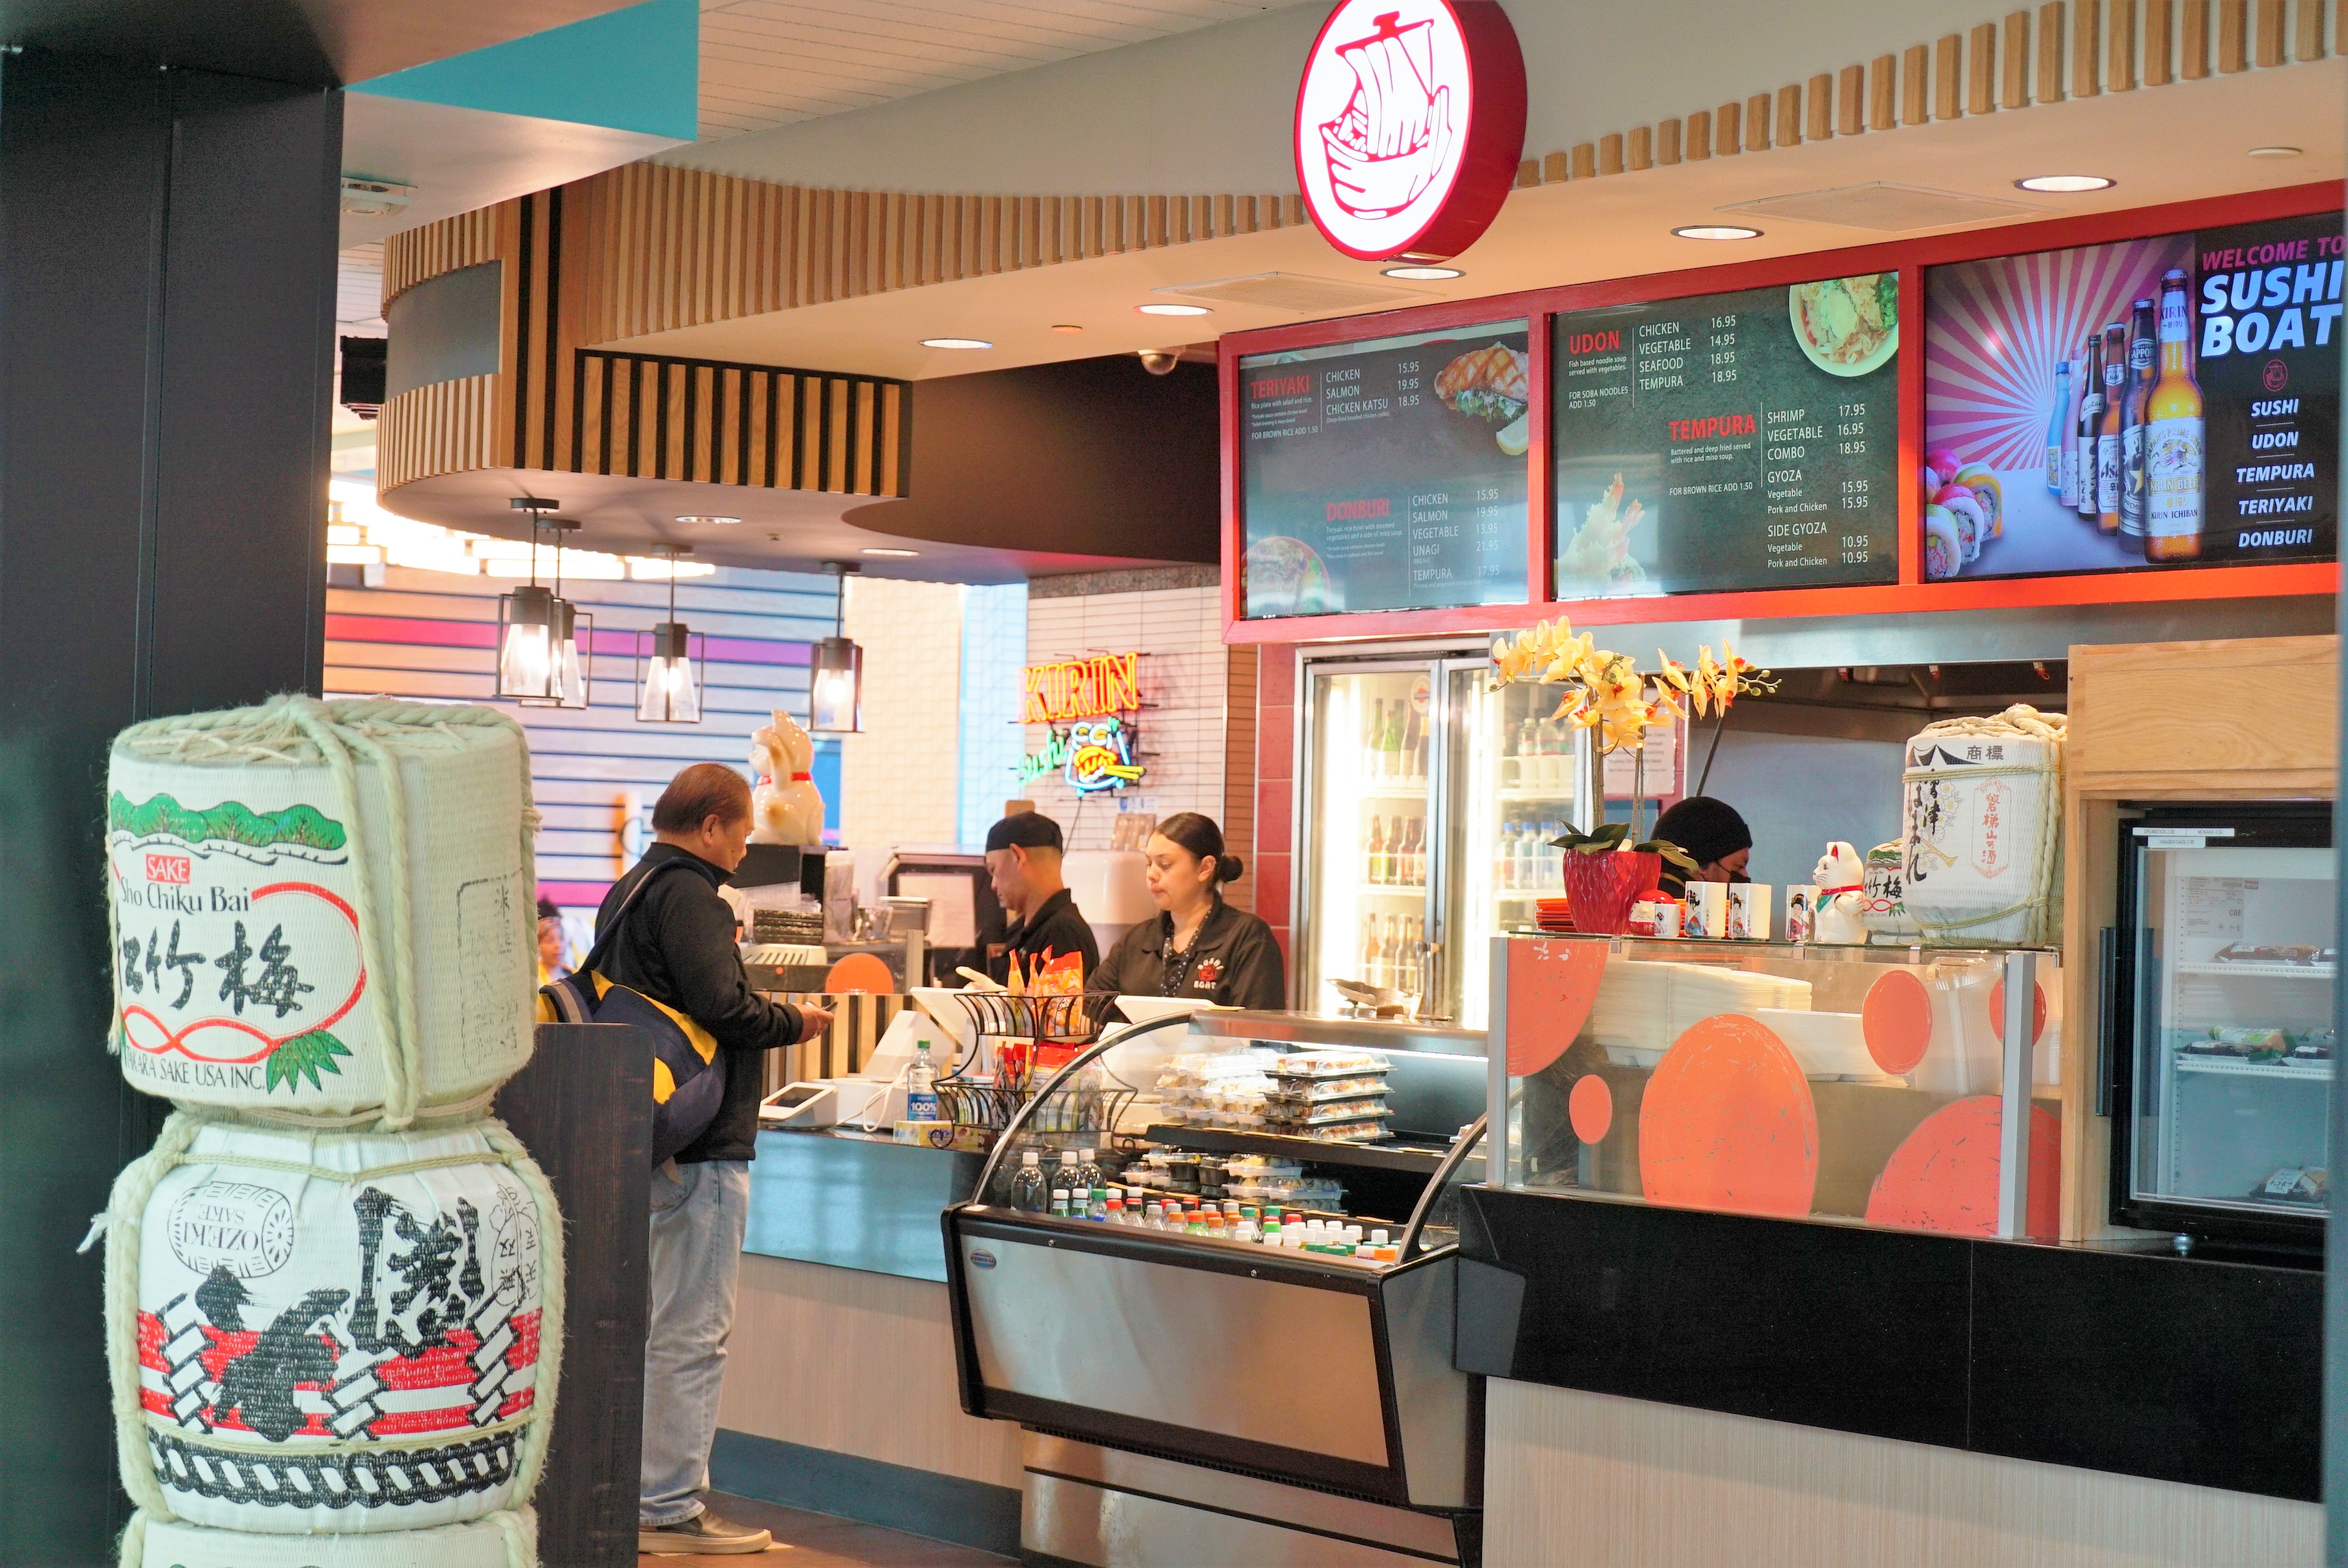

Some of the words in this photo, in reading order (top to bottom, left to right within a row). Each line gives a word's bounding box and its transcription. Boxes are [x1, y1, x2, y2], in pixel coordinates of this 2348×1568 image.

[2202, 240, 2309, 271] WELCOME
[2317, 235, 2346, 257] TO
[2200, 260, 2344, 313] SUSHI
[2161, 306, 2187, 320] KIRIN
[1639, 321, 1679, 337] CHICKEN
[1711, 315, 1736, 329] 16.95
[2201, 303, 2343, 357] BOAT
[1569, 330, 1620, 354] UDON
[1639, 338, 1691, 355] VEGETABLE
[1710, 334, 1735, 346] 14.95
[1596, 356, 1613, 365] noodle
[1639, 357, 1683, 373] SEAFOOD
[1711, 351, 1735, 365] 18.95
[1398, 361, 1420, 374] 15.95
[1598, 364, 1627, 374] vegetables.
[1326, 369, 1360, 383] CHICKEN
[1639, 375, 1683, 390] TEMPURA
[1712, 370, 1736, 383] 18.95
[1250, 375, 1310, 399] TERIYAKI
[1397, 378, 1418, 390] 19.95
[1326, 385, 1359, 399] SALMON
[1582, 389, 1598, 398] SOBA
[1600, 386, 1628, 396] NOODLES
[1326, 401, 1361, 415] CHICKEN
[1363, 398, 1388, 411] KATSU
[1398, 395, 1420, 407] 18.95
[1569, 401, 1582, 409] ADD
[1584, 399, 1596, 408] 1.50
[2251, 398, 2299, 417] SUSHI
[1768, 409, 1805, 424] SHRIMP
[1839, 403, 1865, 418] 17.95
[1263, 429, 1282, 439] BROWN
[1283, 428, 1293, 436] RICE
[1295, 427, 1306, 435] ADD
[1668, 414, 1756, 441] TEMPURA
[1768, 426, 1823, 442] VEGETABLE
[1837, 422, 1864, 436] 16.95
[2252, 431, 2299, 450] UDON
[1671, 447, 1693, 456] Battered
[1705, 445, 1719, 455] deep
[1720, 443, 1731, 452] fried
[1733, 442, 1751, 450] served
[1768, 446, 1805, 461] COMBO
[1839, 441, 1865, 455] 18.95
[1719, 452, 1734, 461] soup.
[1768, 470, 1802, 483] GYOZA
[2236, 463, 2315, 483] TEMPURA
[1669, 488, 1682, 496] FOR
[1683, 485, 1706, 495] BROWN
[1709, 484, 1722, 493] RICE
[1724, 483, 1738, 491] ADD
[1740, 482, 1753, 490] 1.50
[1842, 480, 1868, 493] 15.95
[2150, 479, 2174, 491] KIRIN
[2178, 479, 2198, 490] BEER
[1413, 493, 1448, 506] CHICKEN
[1476, 489, 1498, 501] 15.95
[1768, 488, 1802, 500] Vegetable
[1326, 498, 1390, 521] DONBURI
[1768, 505, 1783, 514] Pork
[1785, 504, 1797, 513] and
[1800, 502, 1827, 512] Chicken
[1842, 496, 1868, 509] 15.95
[2239, 496, 2313, 515] TERIYAKI
[1413, 510, 1447, 523] SALMON
[1476, 506, 1498, 518] 19.95
[2172, 509, 2197, 518] ICHIBAN
[1353, 523, 1364, 532] bowl
[1413, 525, 1459, 539] VEGETABLE
[1476, 523, 1497, 534] 13.95
[1768, 524, 1789, 537] SIDE
[1792, 522, 1827, 535] GYOZA
[1842, 535, 1868, 548] 10.95
[2239, 529, 2313, 548] DONBURI
[1413, 544, 1439, 556] UNAGI
[1476, 541, 1498, 551] 21.95
[1768, 542, 1802, 554] Vegetable
[1768, 559, 1783, 568] Pork
[1785, 558, 1797, 567] and
[1800, 557, 1827, 566] Chicken
[1842, 551, 1868, 563] 10.95
[1413, 568, 1452, 581] TEMPURA
[1478, 565, 1499, 576] 17.95
[1017, 652, 1139, 723] KIRIN
[1017, 729, 1069, 787] Sushi
[1966, 745, 2004, 760] 商標
[147, 856, 187, 882] SAKE
[121, 877, 142, 906] Sho
[148, 883, 201, 915] Chiku
[211, 886, 249, 911] Bai
[1193, 980, 1216, 990] BOAT
[126, 1046, 157, 1078] TAKARA
[161, 1059, 189, 1083] SAKE
[195, 1064, 226, 1087] USA
[231, 1067, 265, 1089] INC.
[911, 1102, 936, 1112] 100%
[198, 1204, 245, 1225] SAKE
[183, 1221, 258, 1252] OZEKI
